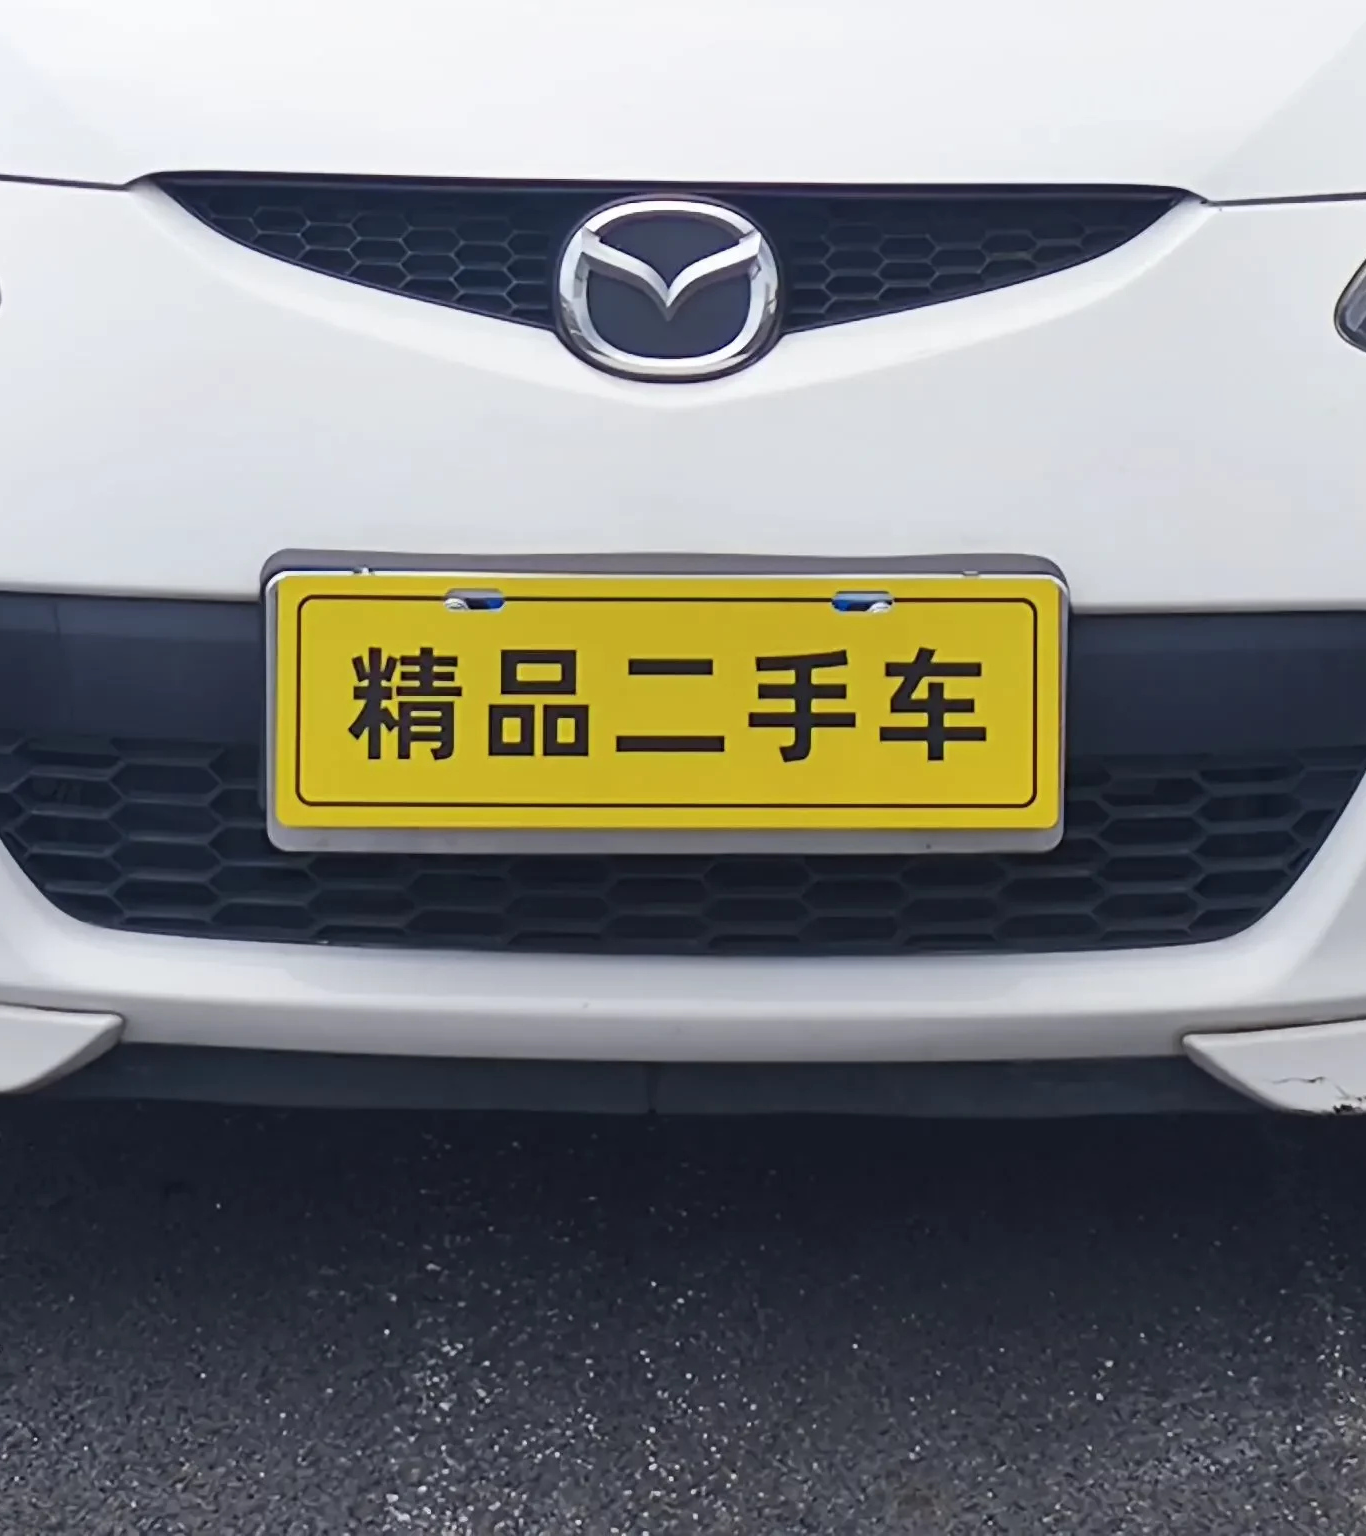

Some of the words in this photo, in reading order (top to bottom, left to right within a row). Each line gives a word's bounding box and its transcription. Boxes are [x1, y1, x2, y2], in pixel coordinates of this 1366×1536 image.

[348, 646, 987, 764] 精品二手车
